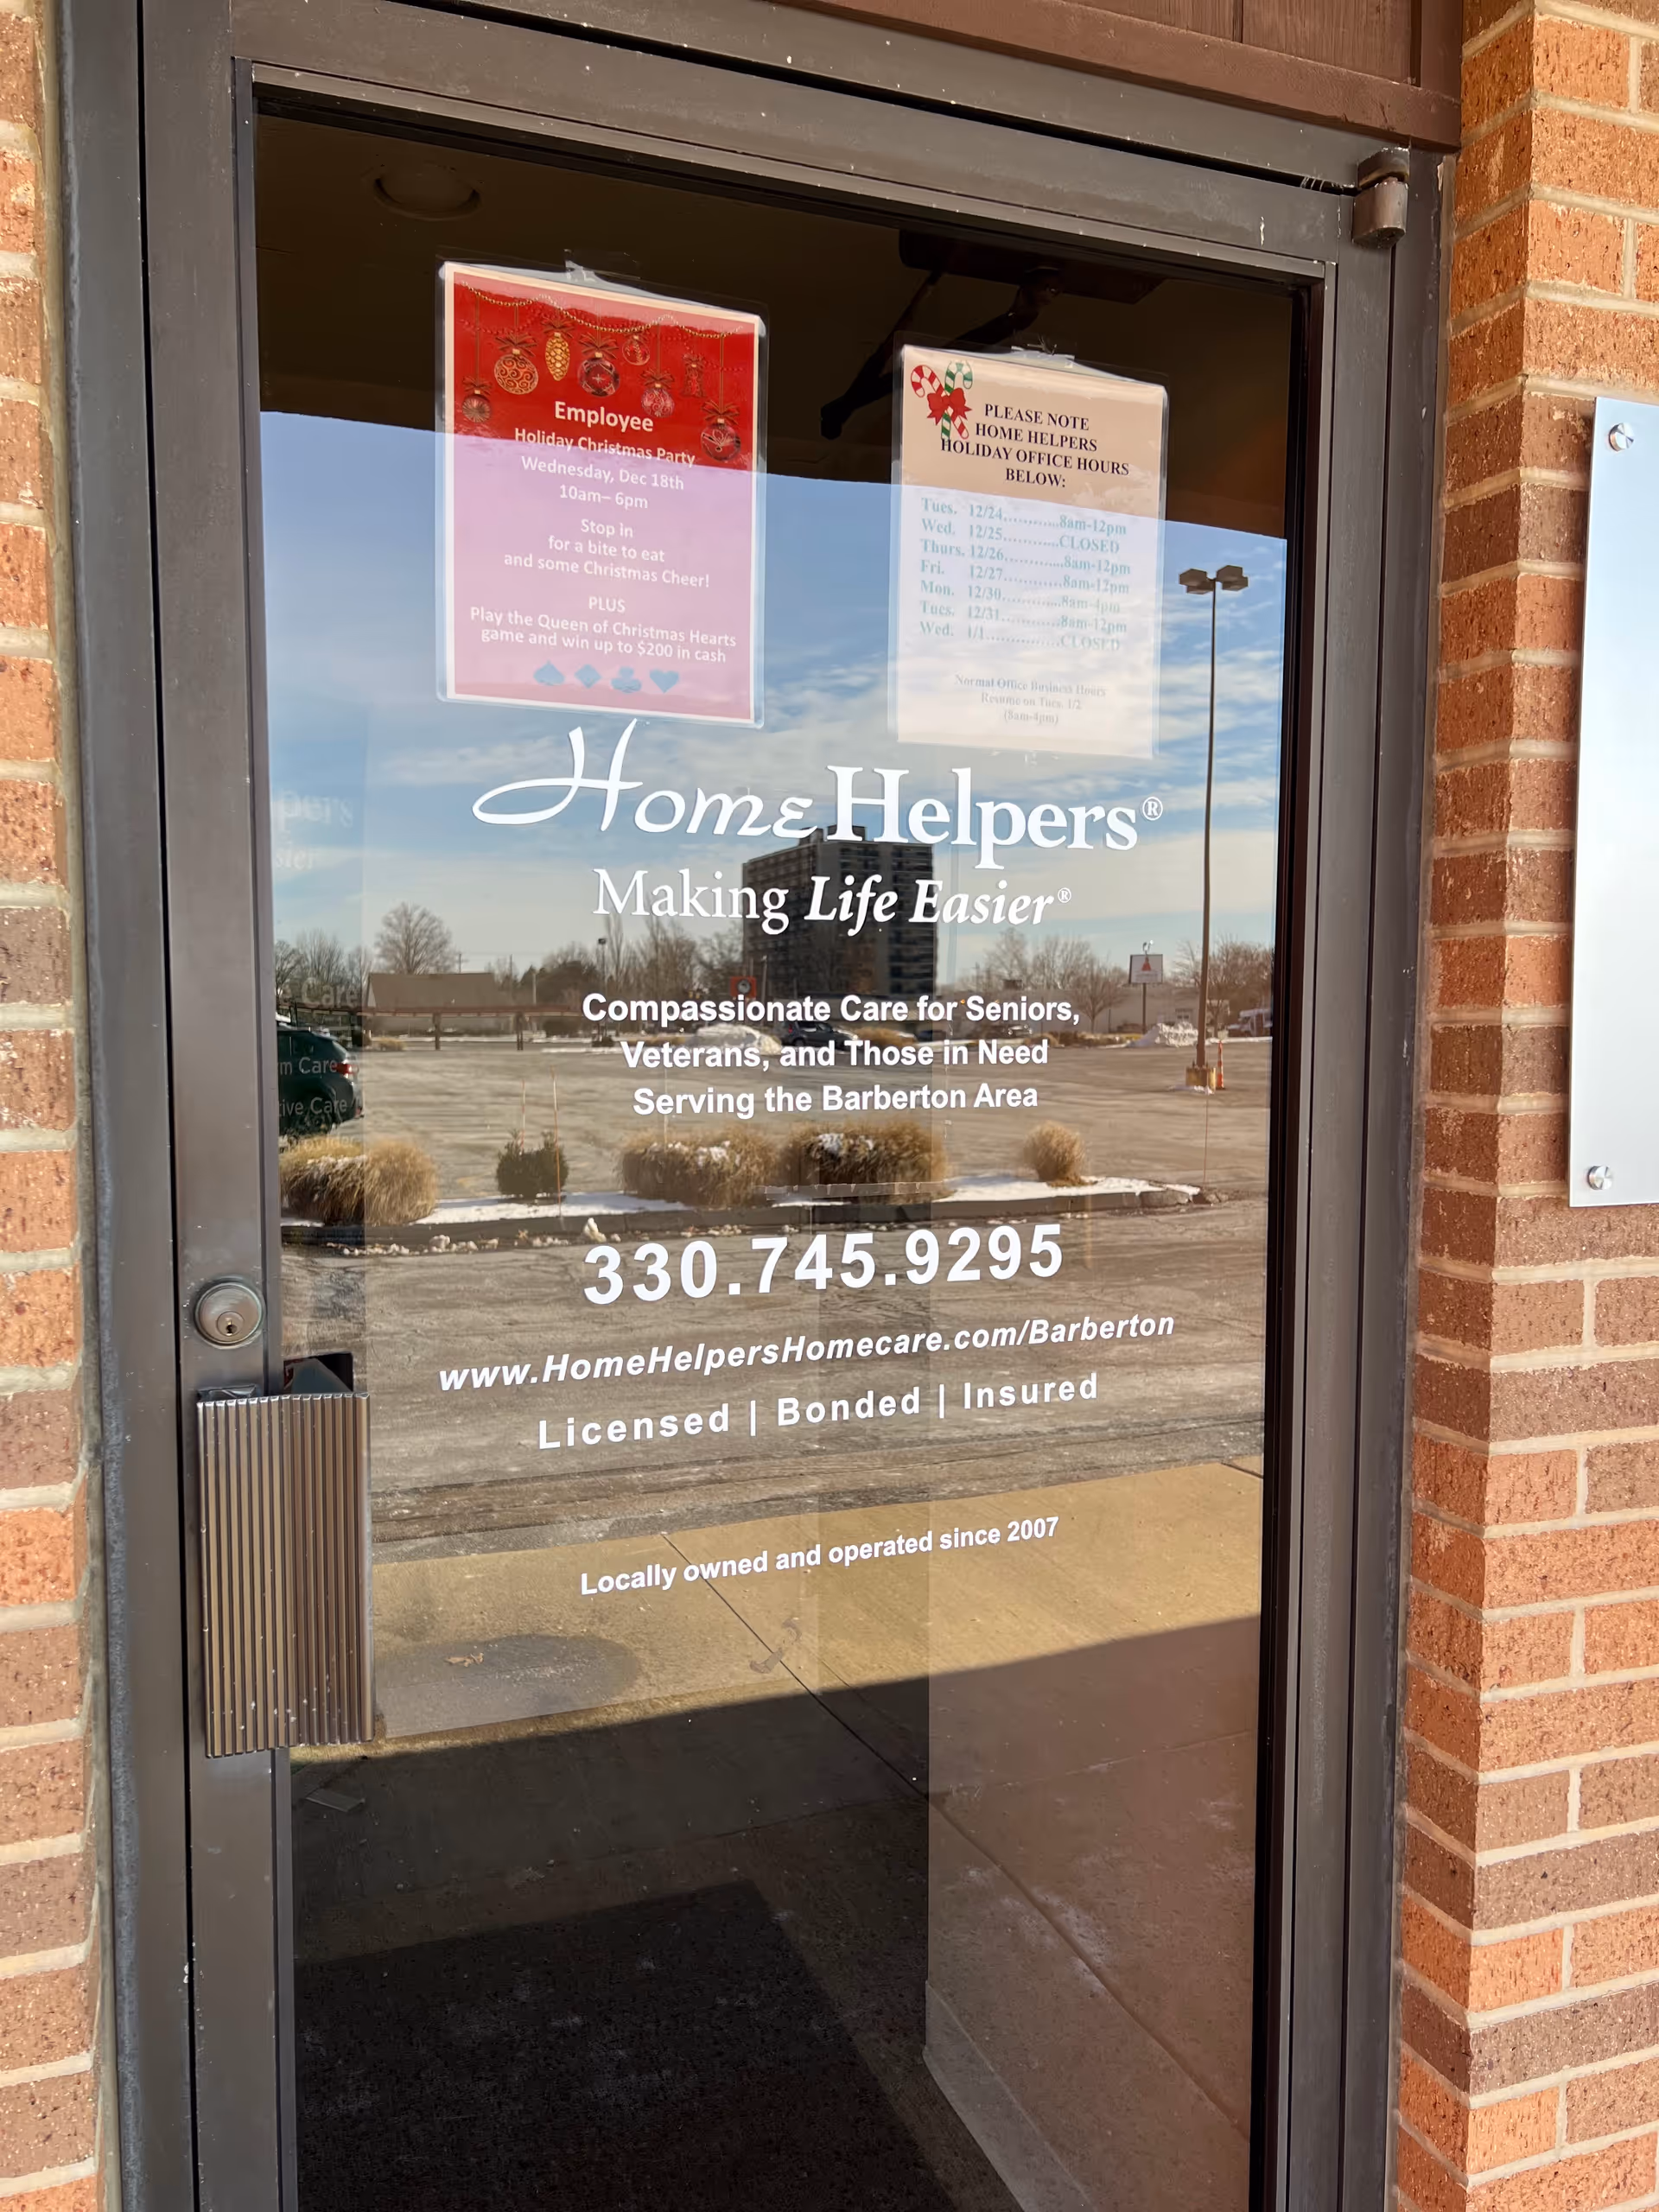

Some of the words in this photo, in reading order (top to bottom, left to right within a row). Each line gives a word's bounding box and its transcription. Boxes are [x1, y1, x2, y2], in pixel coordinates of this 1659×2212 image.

[555, 401, 653, 432] Employee
[985, 404, 1043, 424] PLEASE
[1047, 413, 1089, 430] NOTE
[515, 428, 573, 453] Holiday
[578, 437, 652, 461] Christmas
[657, 447, 696, 468] Party
[976, 423, 1023, 442] HOME
[1028, 430, 1097, 452] HELPERS
[522, 455, 614, 484] Wednesday,
[620, 469, 646, 486] Dec
[652, 473, 683, 491] 18th
[941, 438, 1013, 460] HOLIDAY
[1016, 449, 1071, 468] OFFICE
[1077, 458, 1129, 475] HOURS
[1006, 468, 1065, 488] BELOW:
[615, 493, 648, 510] 6pm
[921, 498, 957, 514] Tues.
[581, 518, 614, 537] Stop
[620, 523, 633, 537] in
[922, 518, 955, 535] Wed.
[549, 536, 570, 551] for
[575, 541, 583, 552] a
[588, 539, 616, 556] bite
[621, 543, 637, 559] to
[641, 547, 664, 562] eat
[920, 539, 965, 556] Thurs.
[505, 553, 532, 568] and
[537, 557, 579, 573] some
[584, 561, 658, 582] Christmas
[662, 570, 710, 588] Cheer!
[920, 560, 944, 575] Fri.
[588, 596, 626, 613] PLUS
[920, 580, 954, 595] Mon.
[471, 607, 503, 626] Play
[508, 610, 532, 626] the
[538, 614, 588, 632] Queen
[594, 619, 608, 633] of
[613, 622, 685, 642] Christmas
[690, 631, 736, 647] Hearts
[481, 629, 524, 642] game
[529, 632, 556, 646] and
[563, 634, 588, 650] win
[594, 639, 613, 654] up
[617, 639, 632, 654] to
[638, 640, 672, 658] $200
[677, 645, 690, 659] in
[695, 647, 726, 663] cash
[472, 718, 818, 839] Home
[593, 868, 790, 936] Making
[804, 874, 898, 937] Life
[582, 993, 830, 1027] Compassionate
[840, 995, 908, 1021] Care
[917, 995, 958, 1021] for
[965, 995, 1080, 1026] Seniors,
[620, 1039, 769, 1072] Veterans,
[779, 1039, 836, 1067] and
[844, 1038, 934, 1065] Those
[944, 1038, 969, 1065] in
[978, 1039, 1048, 1065] Need
[632, 1087, 756, 1119] Serving
[765, 1085, 812, 1113] the
[822, 1084, 968, 1111] Barberton
[974, 1082, 1039, 1108] Area
[583, 1224, 1064, 1305] 330.745.9295
[439, 1313, 1175, 1391] www.HomeHelpersHomecare.com/Barberton
[538, 1402, 729, 1449] Licensed
[778, 1387, 920, 1427] Bonded
[964, 1372, 1098, 1410] Insured
[581, 1563, 677, 1596] Locally
[683, 1550, 768, 1582] owned
[775, 1544, 822, 1570] and
[829, 1531, 932, 1567] operated
[939, 1527, 1001, 1549] since
[1007, 1516, 1059, 1542] 2007
